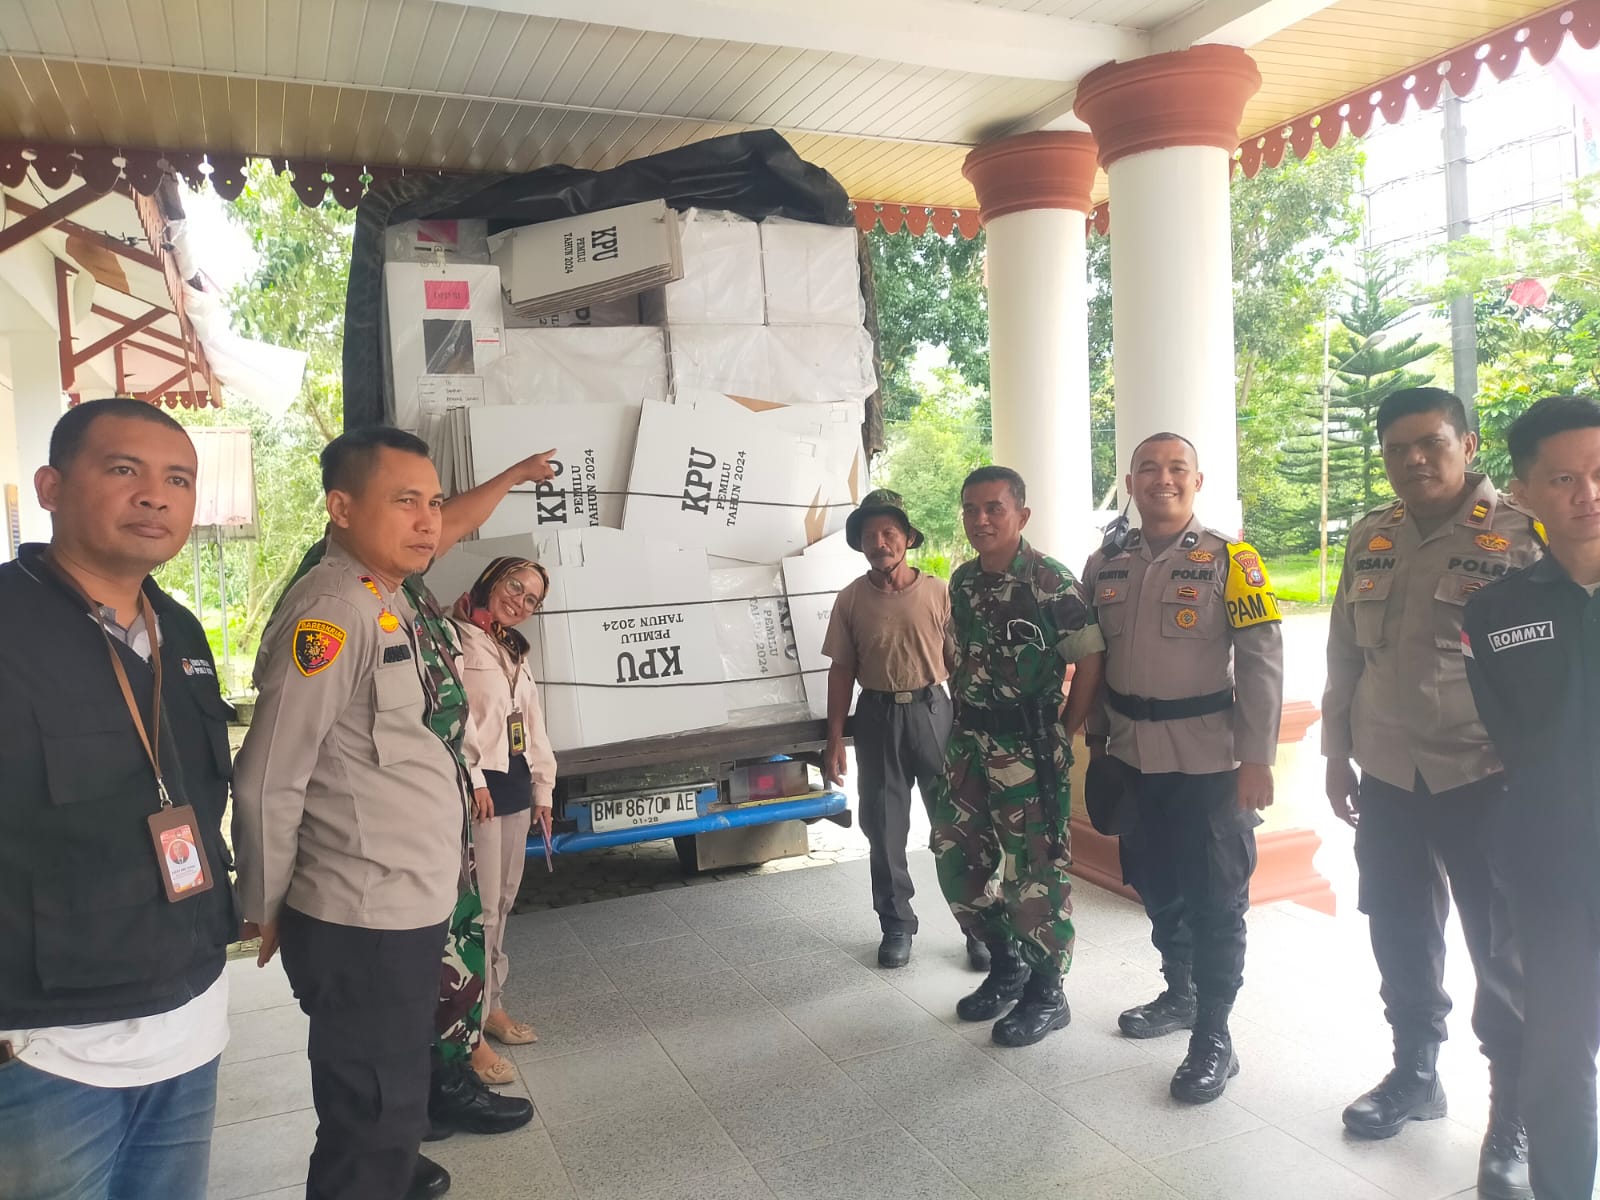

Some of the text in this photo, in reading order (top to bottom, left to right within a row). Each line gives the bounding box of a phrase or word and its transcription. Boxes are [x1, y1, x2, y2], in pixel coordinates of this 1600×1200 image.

[564, 232, 574, 274] TAHUN 2024
[576, 237, 586, 263] PEMILU
[591, 226, 618, 261] KPU
[571, 465, 583, 515] PEMILU
[584, 449, 599, 527] TAHUN 2024
[681, 446, 716, 515] KPU
[716, 462, 731, 510] PEMILU
[726, 450, 747, 527] TAHUN 2024
[1448, 556, 1507, 577] POLR
[602, 613, 684, 631] TAHUN 2024
[1226, 592, 1268, 626] PAM
[301, 622, 343, 640] BARESKRIM
[621, 629, 671, 644] PEMILU
[763, 609, 779, 657] PEMILU
[1493, 624, 1546, 648] ROMMY
[616, 645, 683, 683] KPU
[756, 642, 769, 674] 2024
[594, 792, 694, 821] BM 8670 AE
